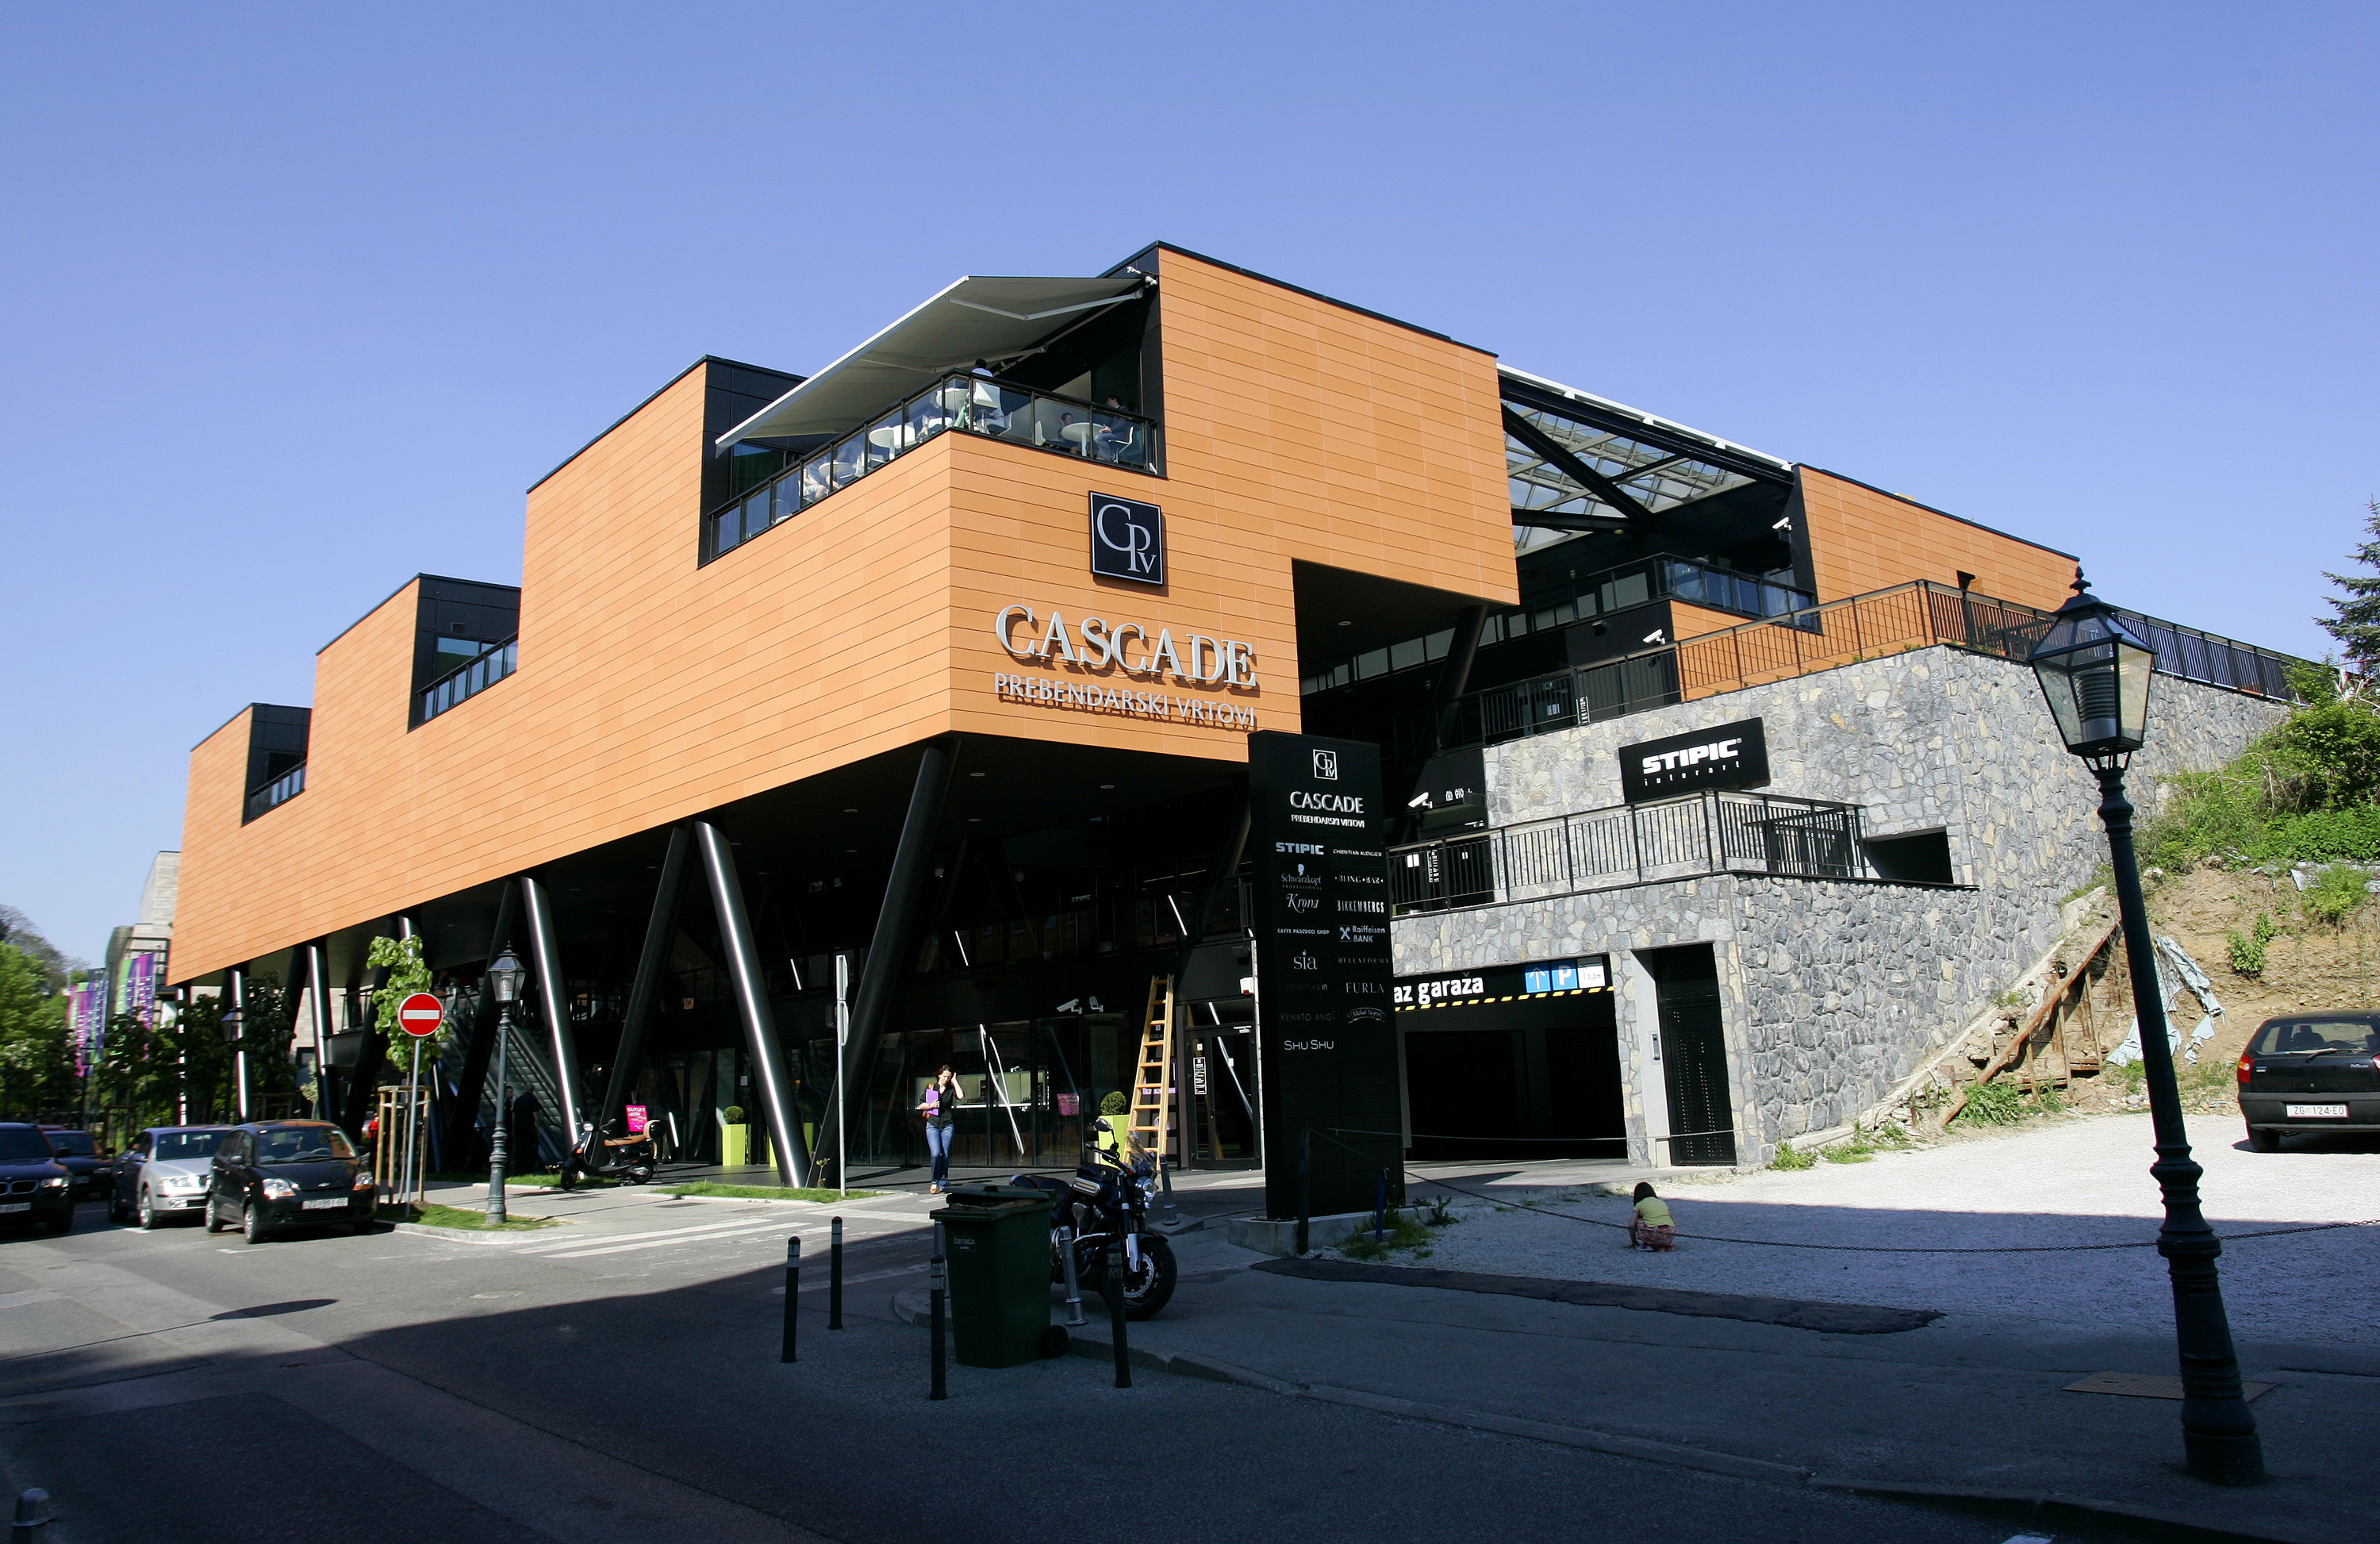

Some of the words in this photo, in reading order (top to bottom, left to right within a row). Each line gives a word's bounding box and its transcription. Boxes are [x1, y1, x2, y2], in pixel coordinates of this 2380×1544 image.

[995, 604, 1257, 687] CASCADE
[994, 672, 1170, 716] PREBENDARSKI
[1175, 697, 1256, 727] VRTOVI
[1645, 760, 1740, 786] interart
[1289, 791, 1365, 813] CASCADE
[1291, 814, 1340, 825] PREBENDARSKI
[1341, 818, 1365, 828] VRTOVI
[1276, 842, 1324, 855] STIPIC
[1281, 874, 1322, 886] Schwarzkopf
[1286, 893, 1319, 913] Krona
[1337, 900, 1384, 913] BIKKEMBERGS
[1293, 950, 1318, 970] sia
[1558, 965, 1573, 985] P
[1345, 981, 1384, 993] FURLA
[1418, 971, 1484, 1004] garaža
[1280, 1013, 1311, 1022] RENATO
[1284, 1040, 1308, 1050] SHU
[1310, 1039, 1334, 1050] SHU
[2294, 1106, 2305, 1115] ZG
